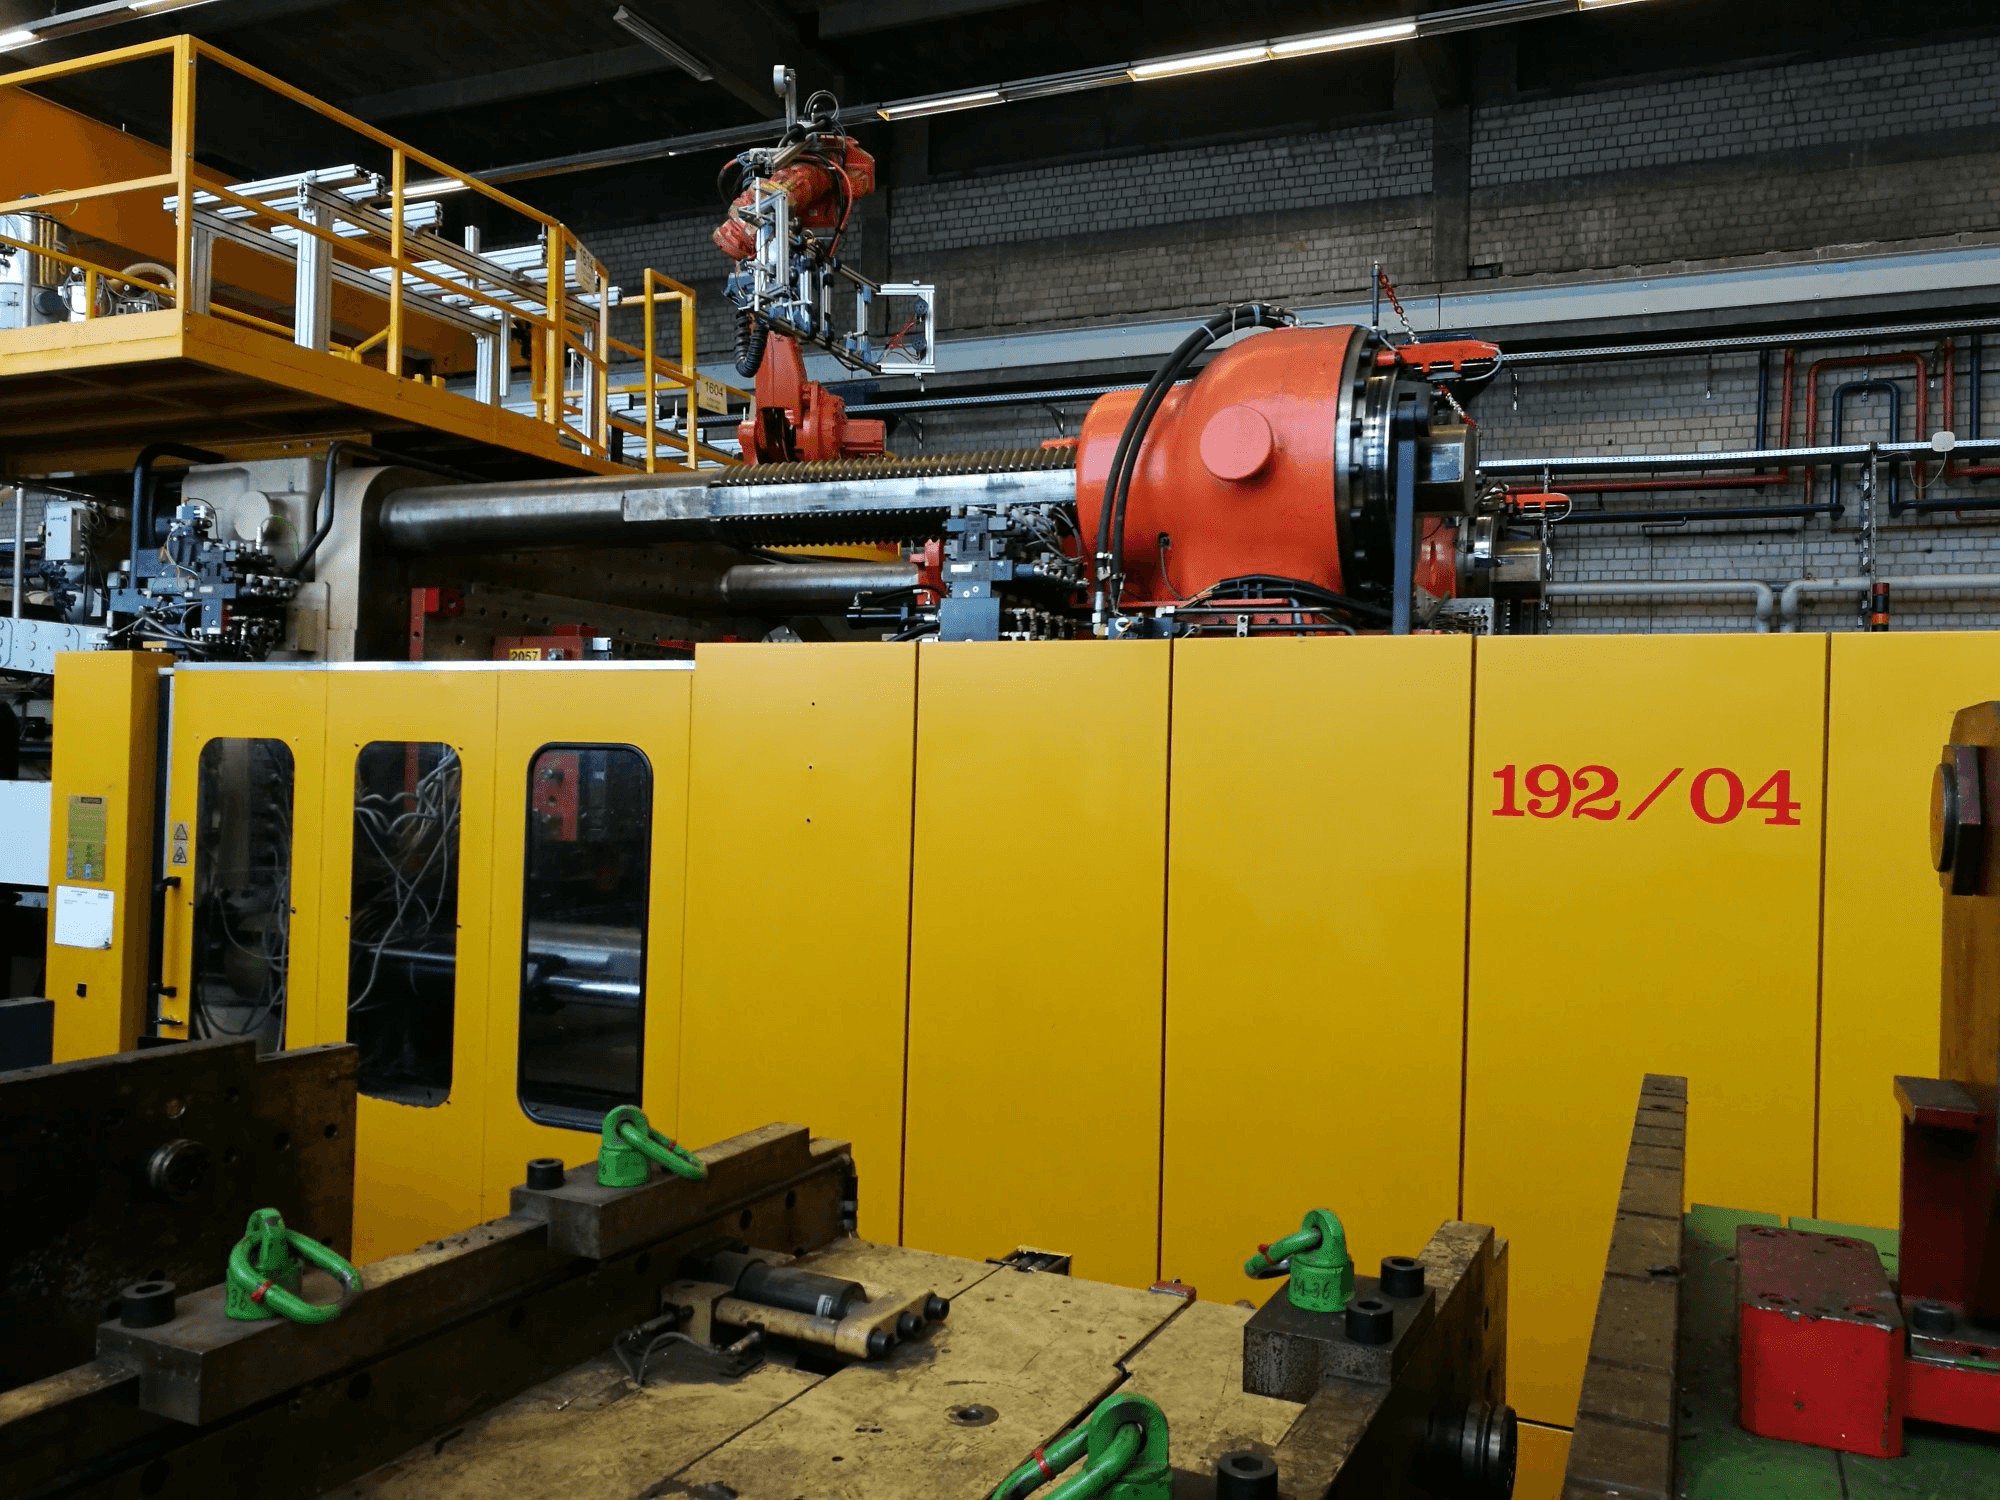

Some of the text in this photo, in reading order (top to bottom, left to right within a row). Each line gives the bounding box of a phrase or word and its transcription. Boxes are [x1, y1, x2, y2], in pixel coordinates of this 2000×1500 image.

[705, 381, 723, 396] 1604
[511, 650, 539, 661] 2057
[1492, 763, 1801, 826] 192/04
